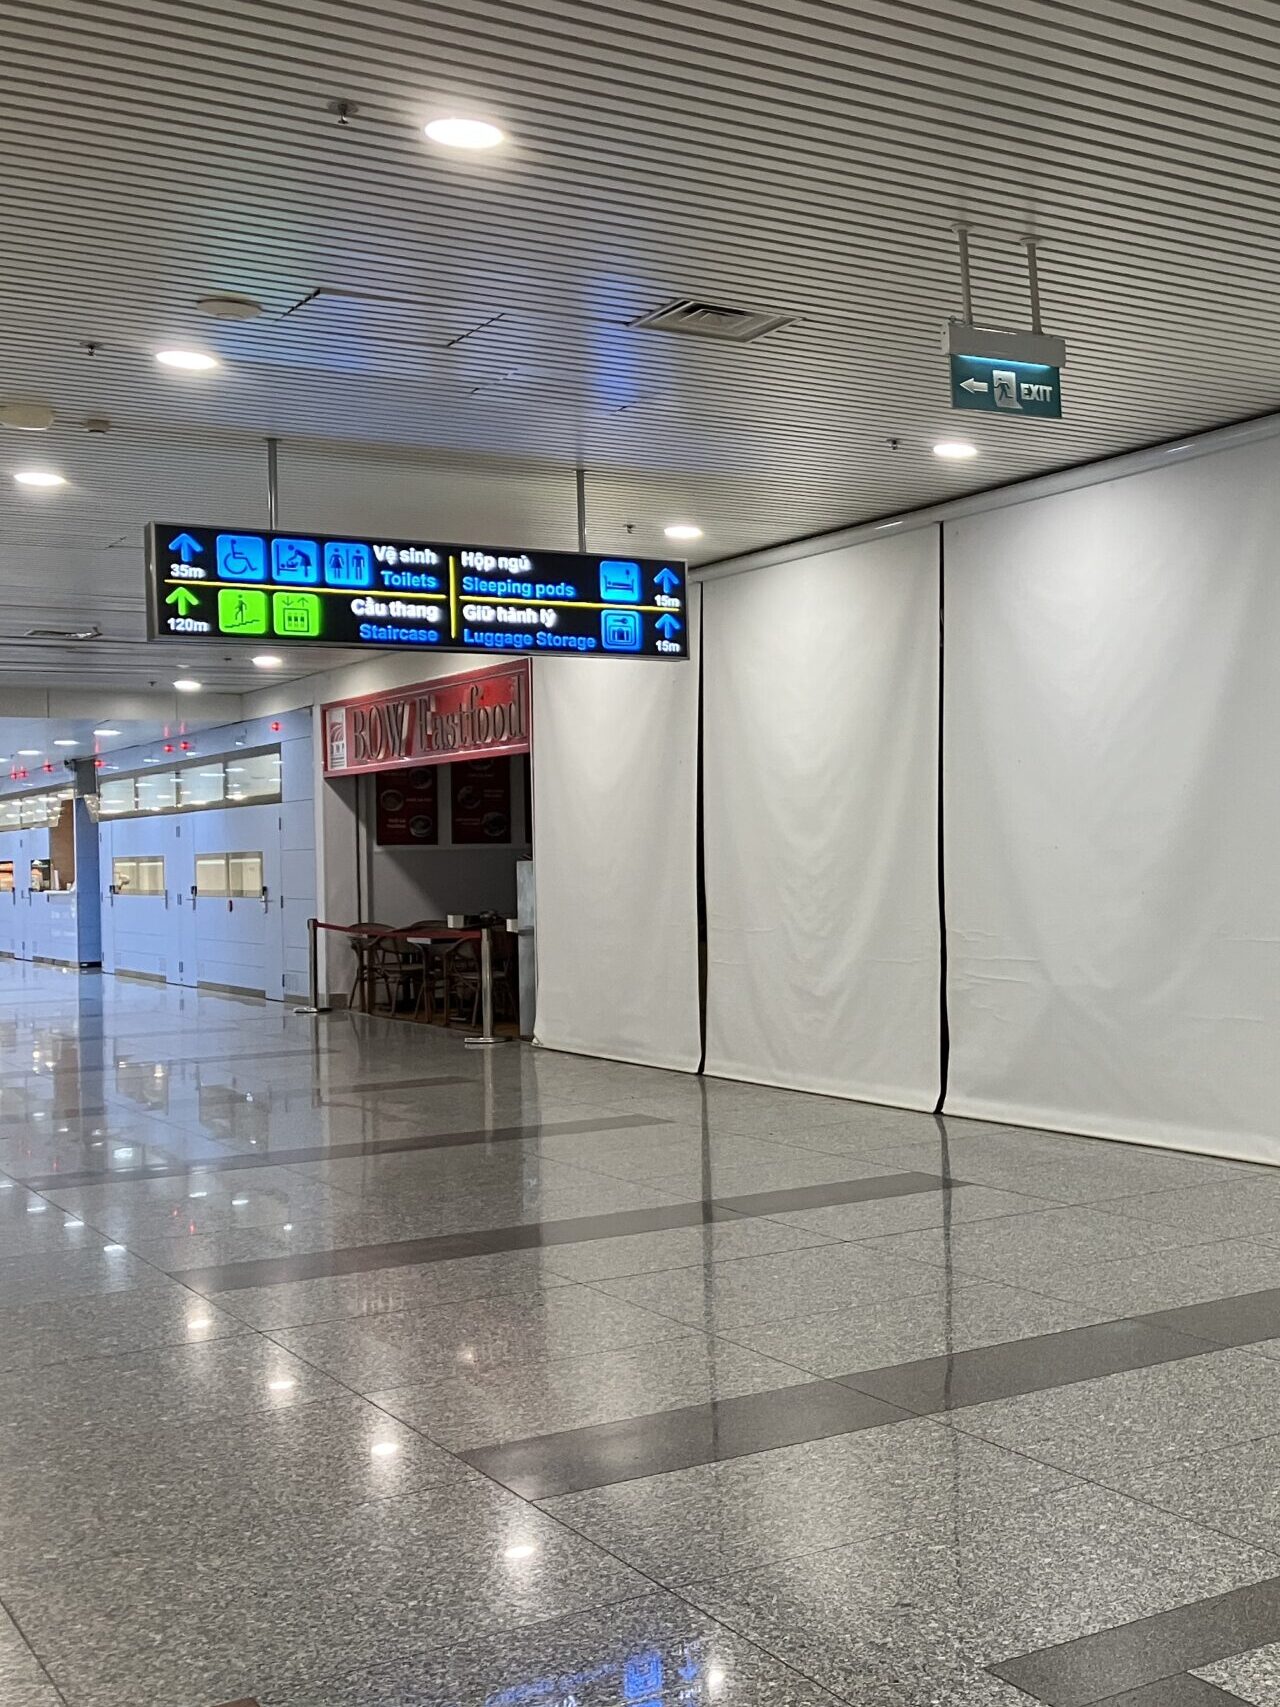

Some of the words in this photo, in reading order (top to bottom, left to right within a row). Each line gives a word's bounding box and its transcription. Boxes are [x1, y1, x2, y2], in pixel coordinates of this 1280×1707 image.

[1020, 383, 1053, 402] EXIT
[373, 545, 398, 565] Vệ
[400, 548, 438, 565] sinh
[461, 551, 497, 571] Hộp
[171, 564, 206, 579] 35m
[380, 571, 438, 588] Toilets
[462, 576, 532, 597] Sleeping
[535, 582, 575, 598] pods
[654, 594, 681, 607] 15m
[389, 601, 441, 622] thang
[497, 607, 538, 624] hành
[540, 608, 558, 628] lý
[167, 618, 210, 633] 120m
[359, 623, 439, 642] Staircase
[464, 629, 533, 648] Luggage
[536, 631, 597, 650] Storage
[655, 640, 681, 652] 15m
[353, 700, 411, 763] BOW
